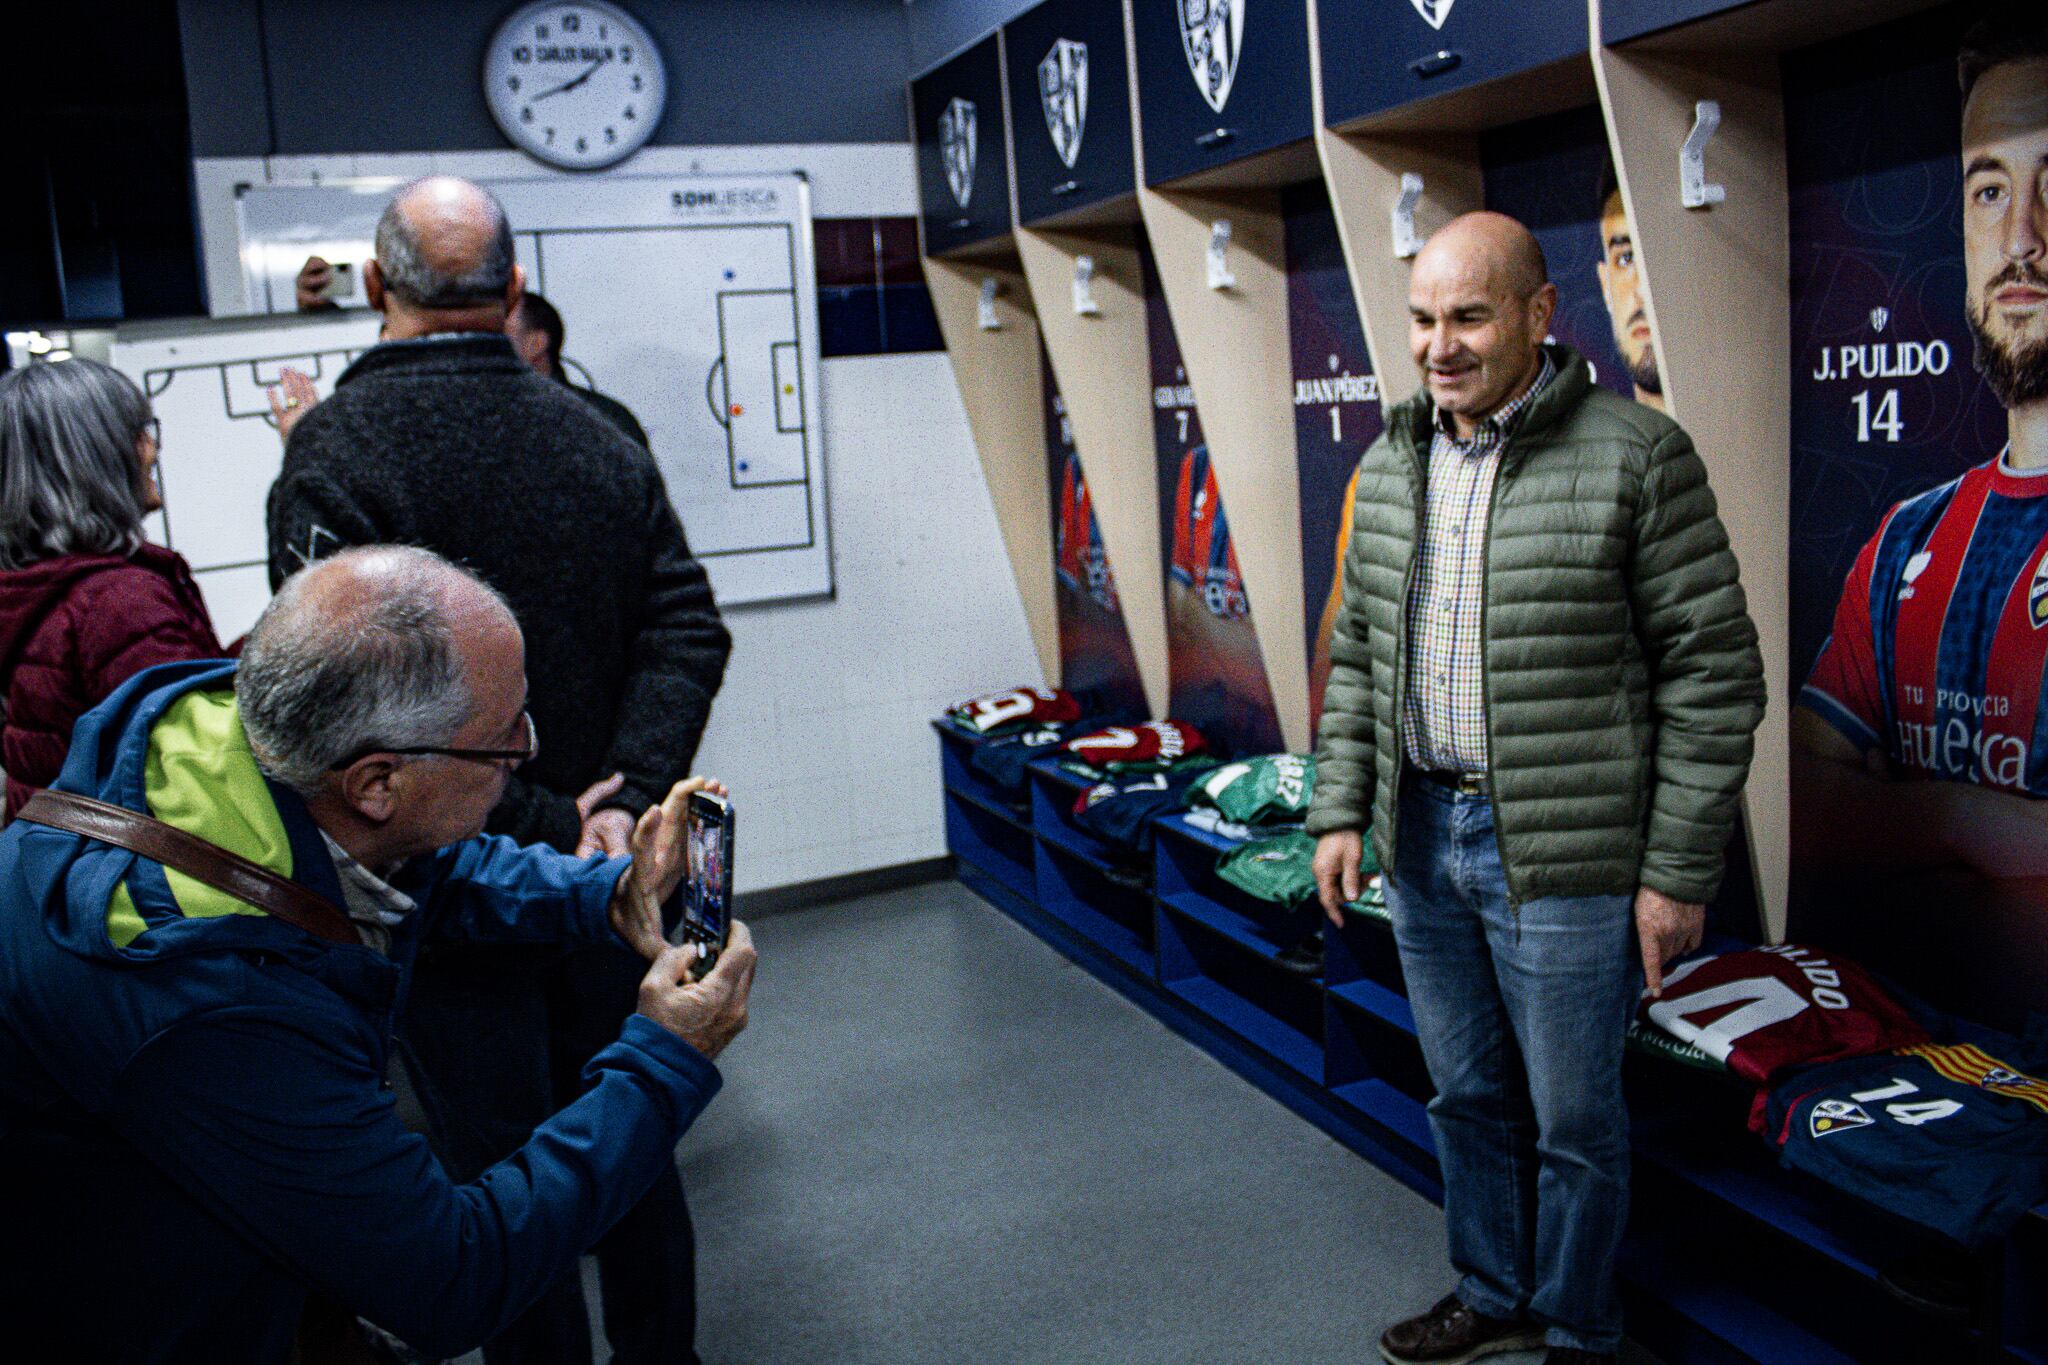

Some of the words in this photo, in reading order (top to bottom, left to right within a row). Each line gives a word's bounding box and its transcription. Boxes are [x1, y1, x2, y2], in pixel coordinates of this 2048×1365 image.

[1813, 347, 1837, 380] J.
[1840, 340, 1949, 379] PULIDO
[1295, 378, 1333, 405] JUAN
[1175, 410, 1189, 443] 7
[1329, 405, 1342, 442] 1
[1851, 389, 1904, 441] 14
[1850, 1077, 1965, 1126] 14
